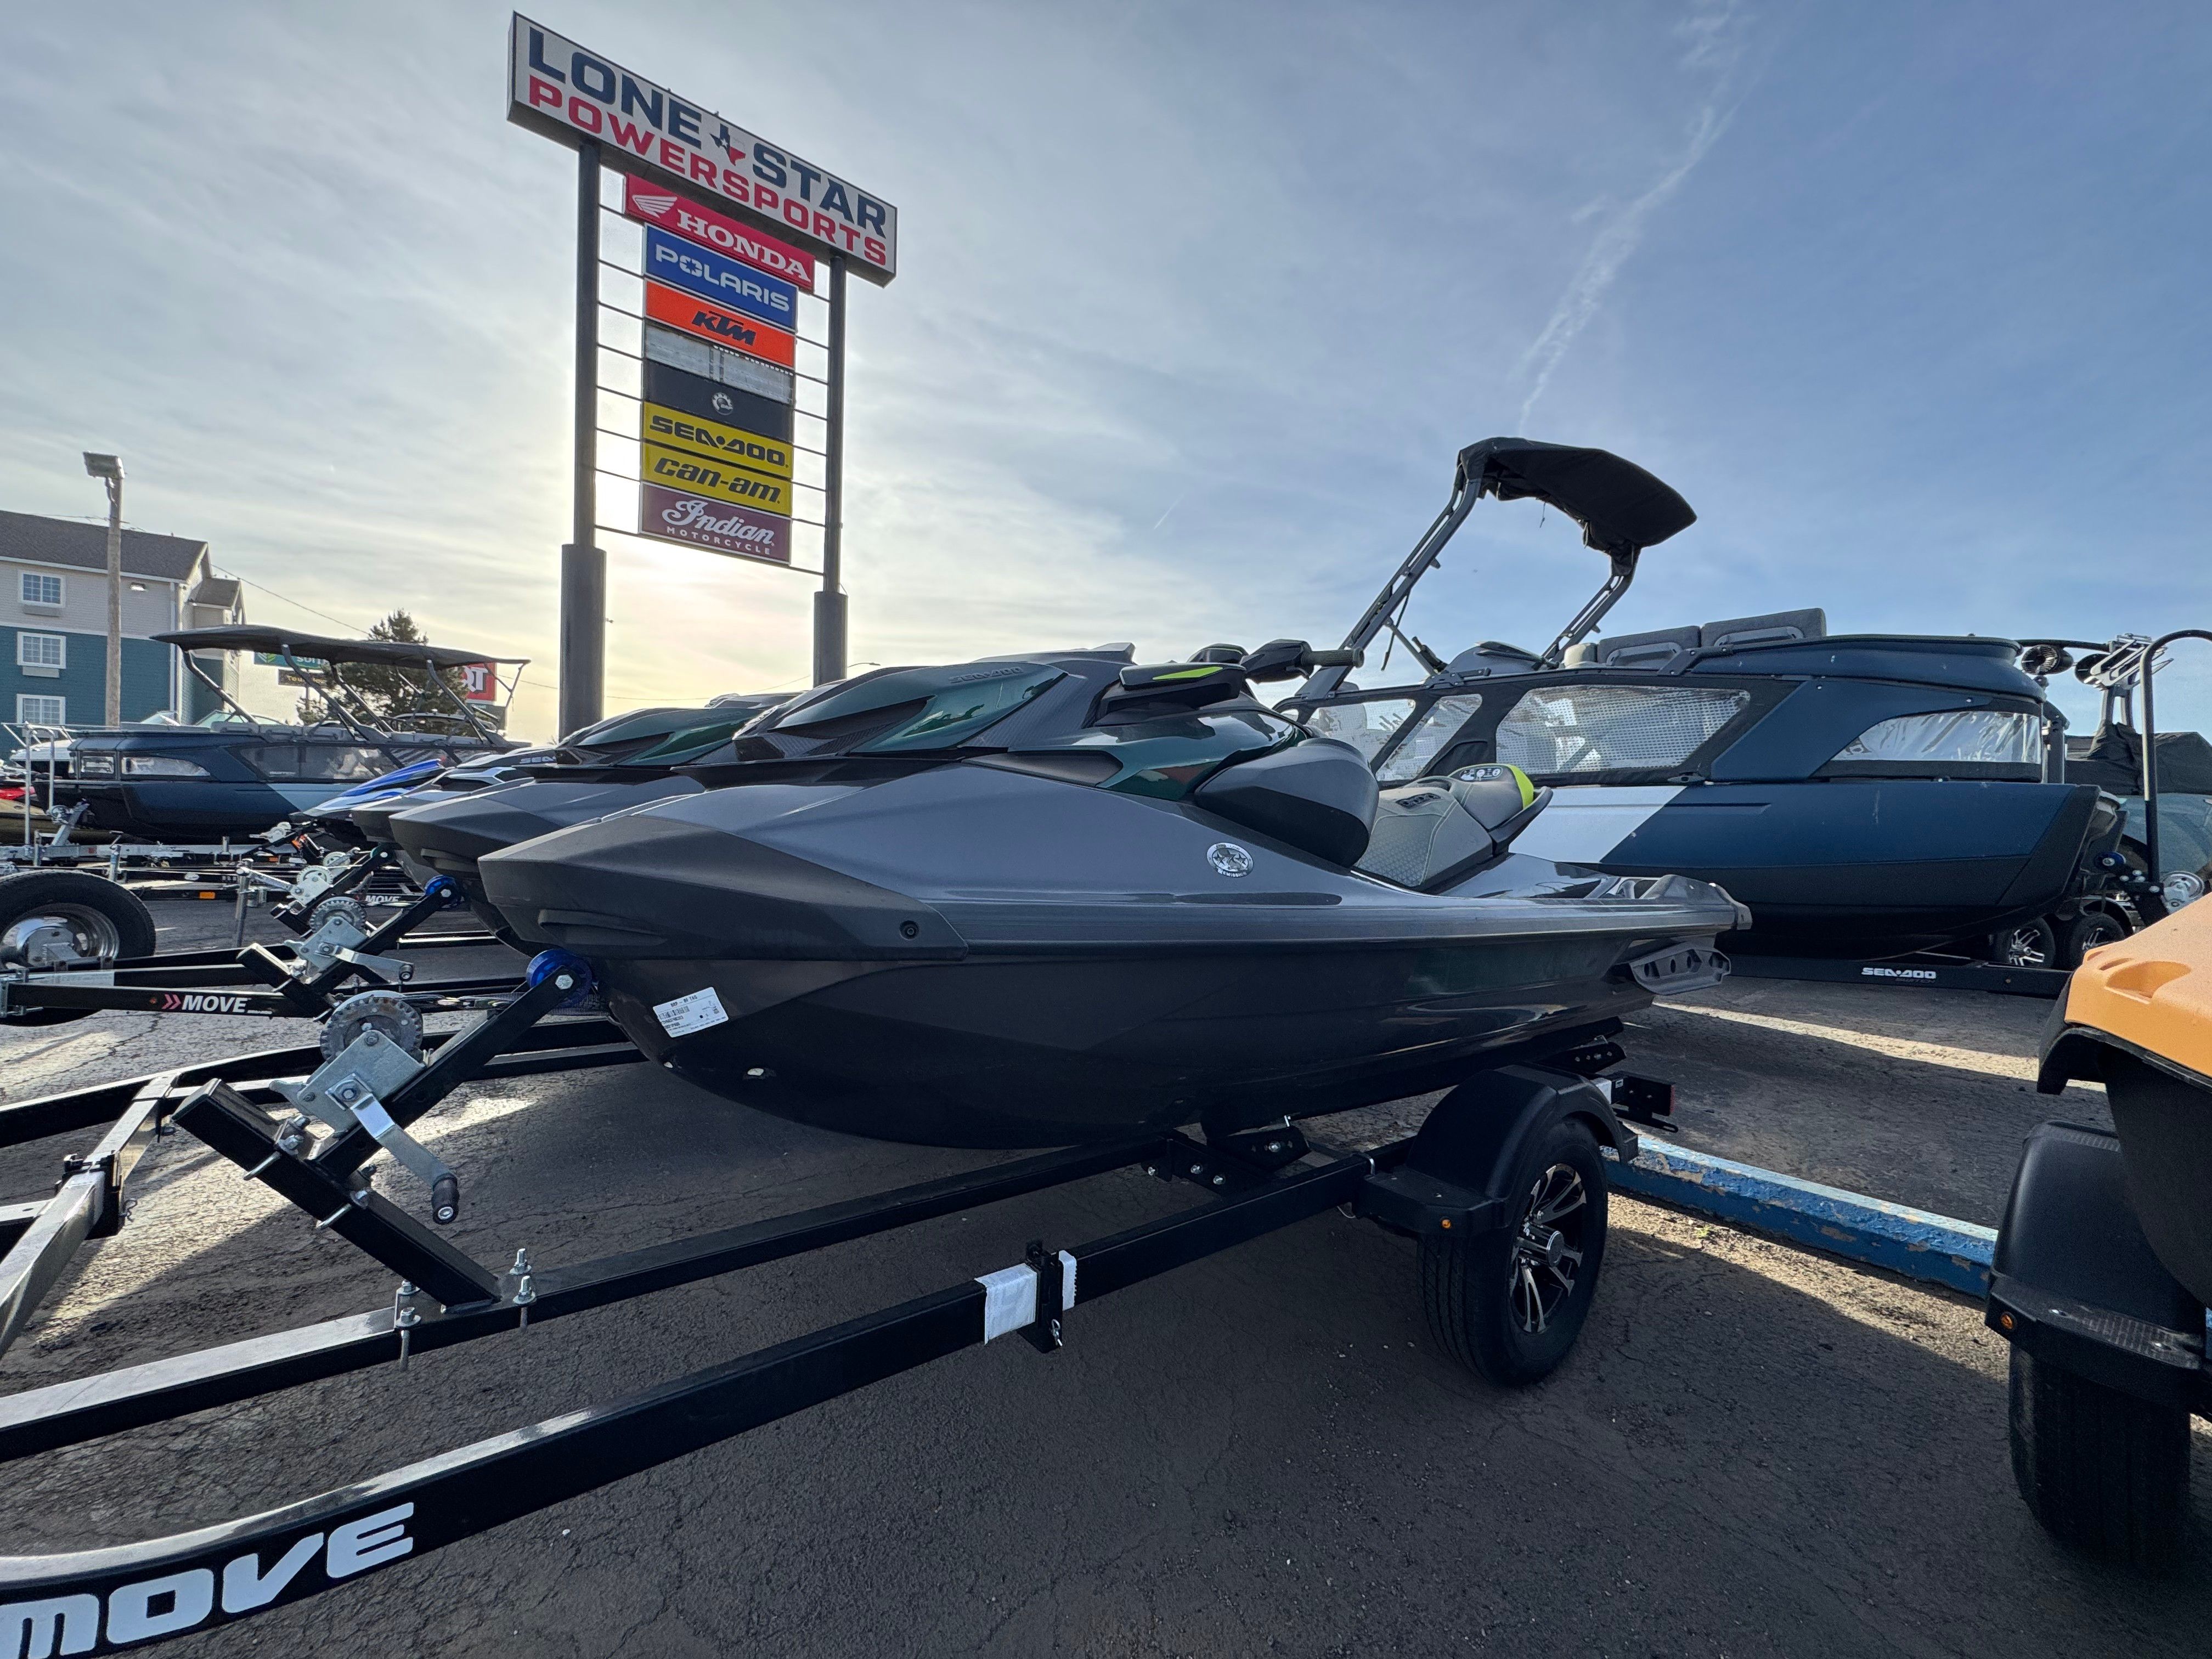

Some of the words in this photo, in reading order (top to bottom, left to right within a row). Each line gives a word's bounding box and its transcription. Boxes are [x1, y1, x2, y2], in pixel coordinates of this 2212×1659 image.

[529, 26, 702, 149] LONE
[753, 143, 886, 240] STAR
[529, 74, 886, 267] POWERSPORTS
[676, 208, 811, 283] HONDA
[654, 244, 790, 312] POLARIS
[691, 311, 757, 346] KTM
[662, 499, 775, 546] Indian
[667, 526, 771, 555] MOTORCYCLE
[365, 895, 401, 903] MOVE
[182, 995, 248, 1013] MOVE
[0, 1502, 414, 1659] MOVE
